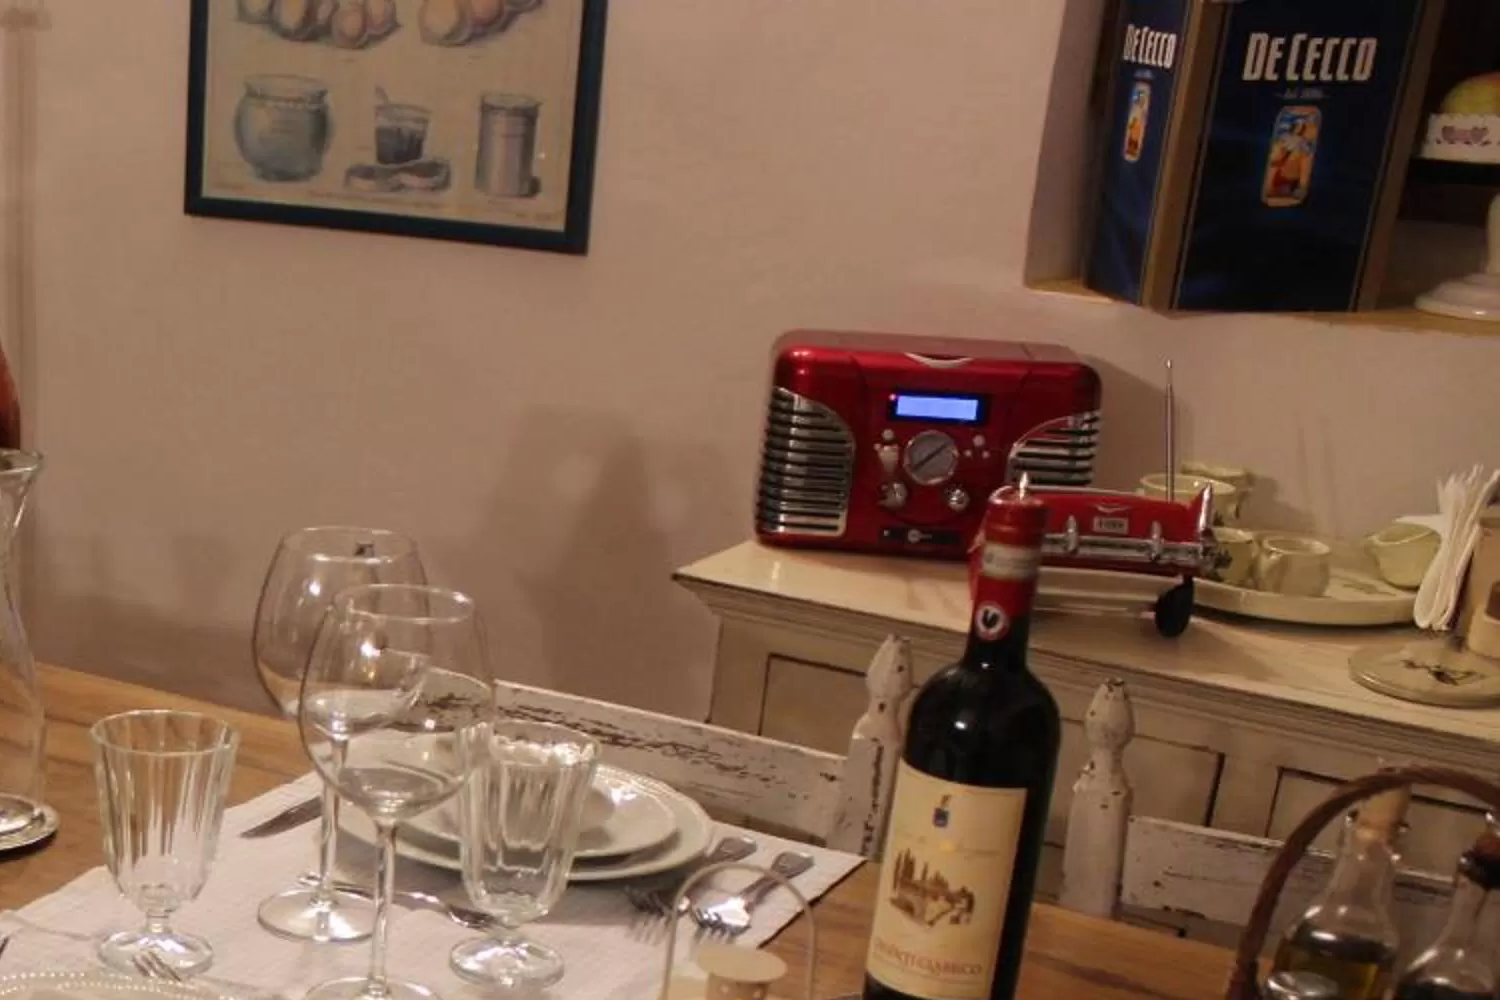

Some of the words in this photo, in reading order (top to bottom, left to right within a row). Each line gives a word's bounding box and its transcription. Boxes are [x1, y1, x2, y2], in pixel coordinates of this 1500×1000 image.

[1123, 24, 1141, 62] DE
[1136, 26, 1177, 69] CECCO
[1242, 33, 1285, 81] DE
[1285, 33, 1378, 81] CECCO
[915, 955, 983, 976] CLACO
